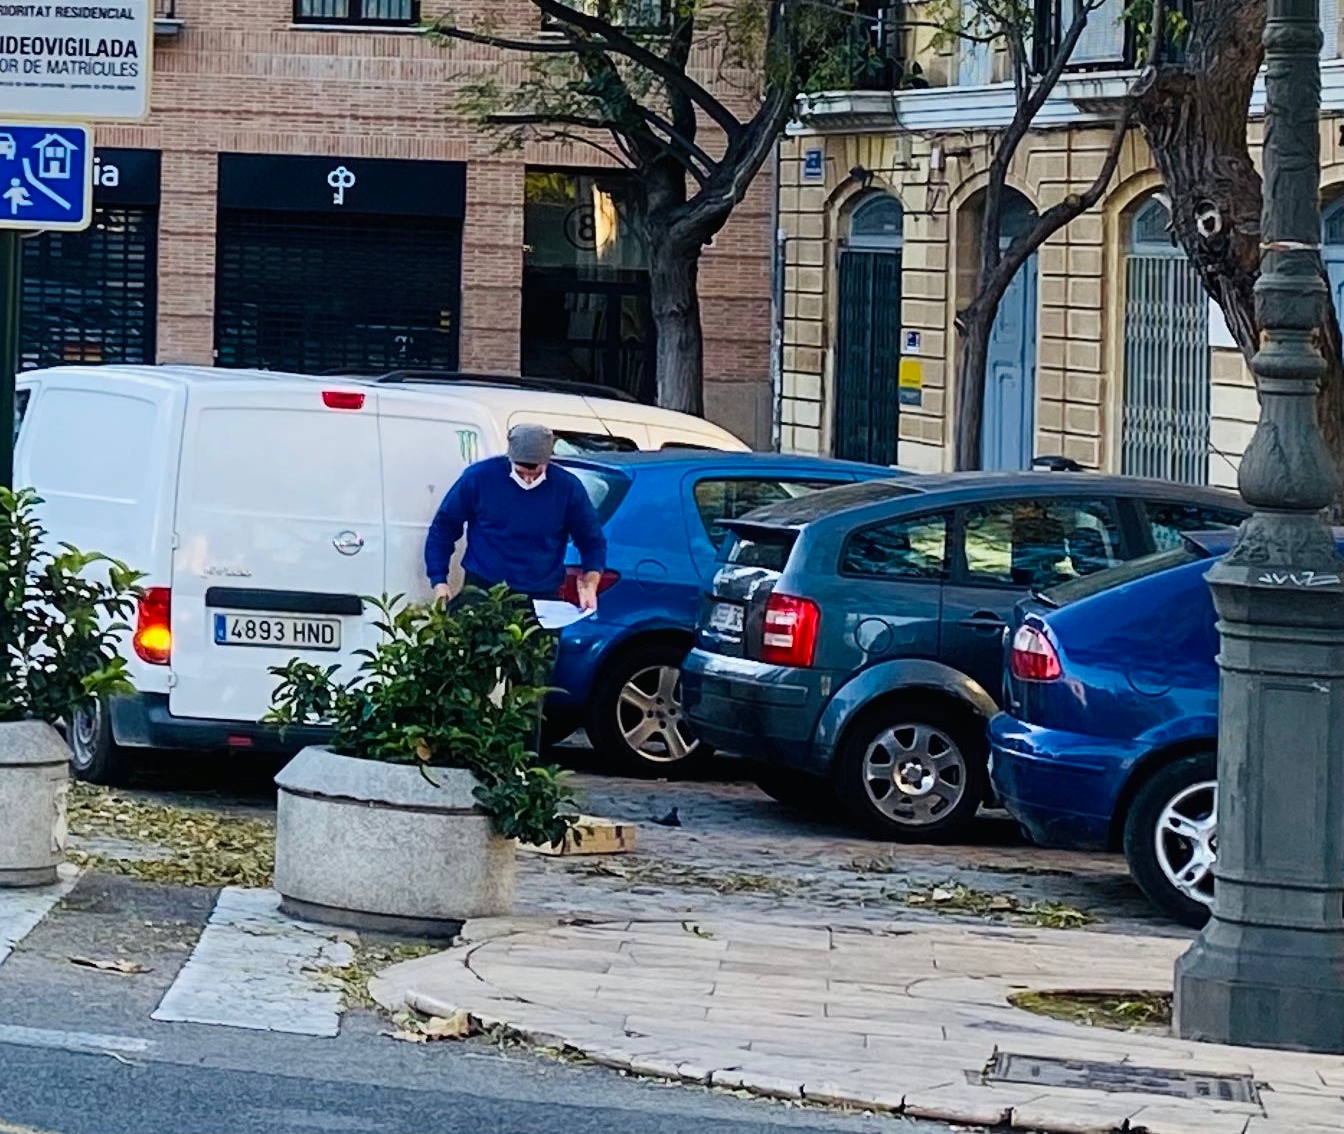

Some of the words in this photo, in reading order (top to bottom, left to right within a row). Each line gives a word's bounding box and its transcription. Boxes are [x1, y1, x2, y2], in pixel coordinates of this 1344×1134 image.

[55, 6, 135, 20] RESIDENCIAL
[23, 59, 42, 74] DE
[47, 58, 138, 77] MATRÍCULES
[231, 619, 285, 641] 4893
[293, 622, 334, 644] HND
